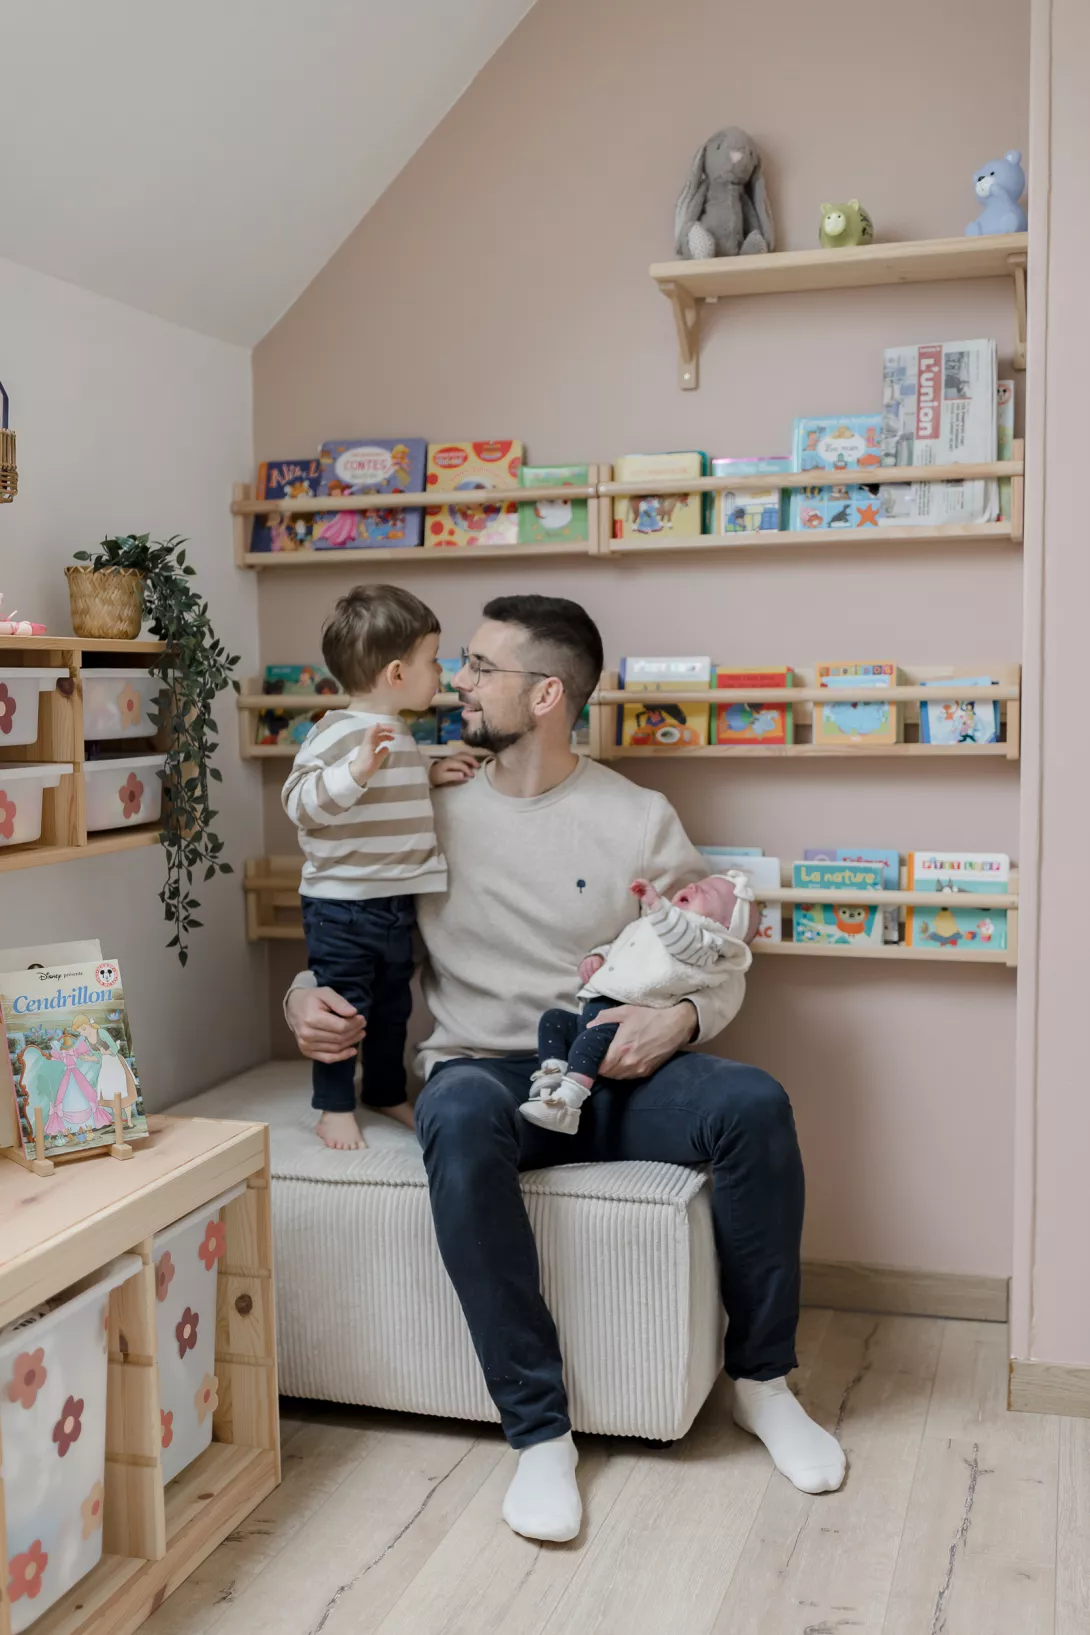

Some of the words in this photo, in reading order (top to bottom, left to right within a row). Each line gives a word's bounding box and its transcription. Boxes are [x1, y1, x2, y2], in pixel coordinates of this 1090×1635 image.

[918, 358, 940, 437] L'union
[801, 866, 821, 882] La
[823, 868, 876, 884] nature
[13, 985, 113, 1014] Cendrillon
